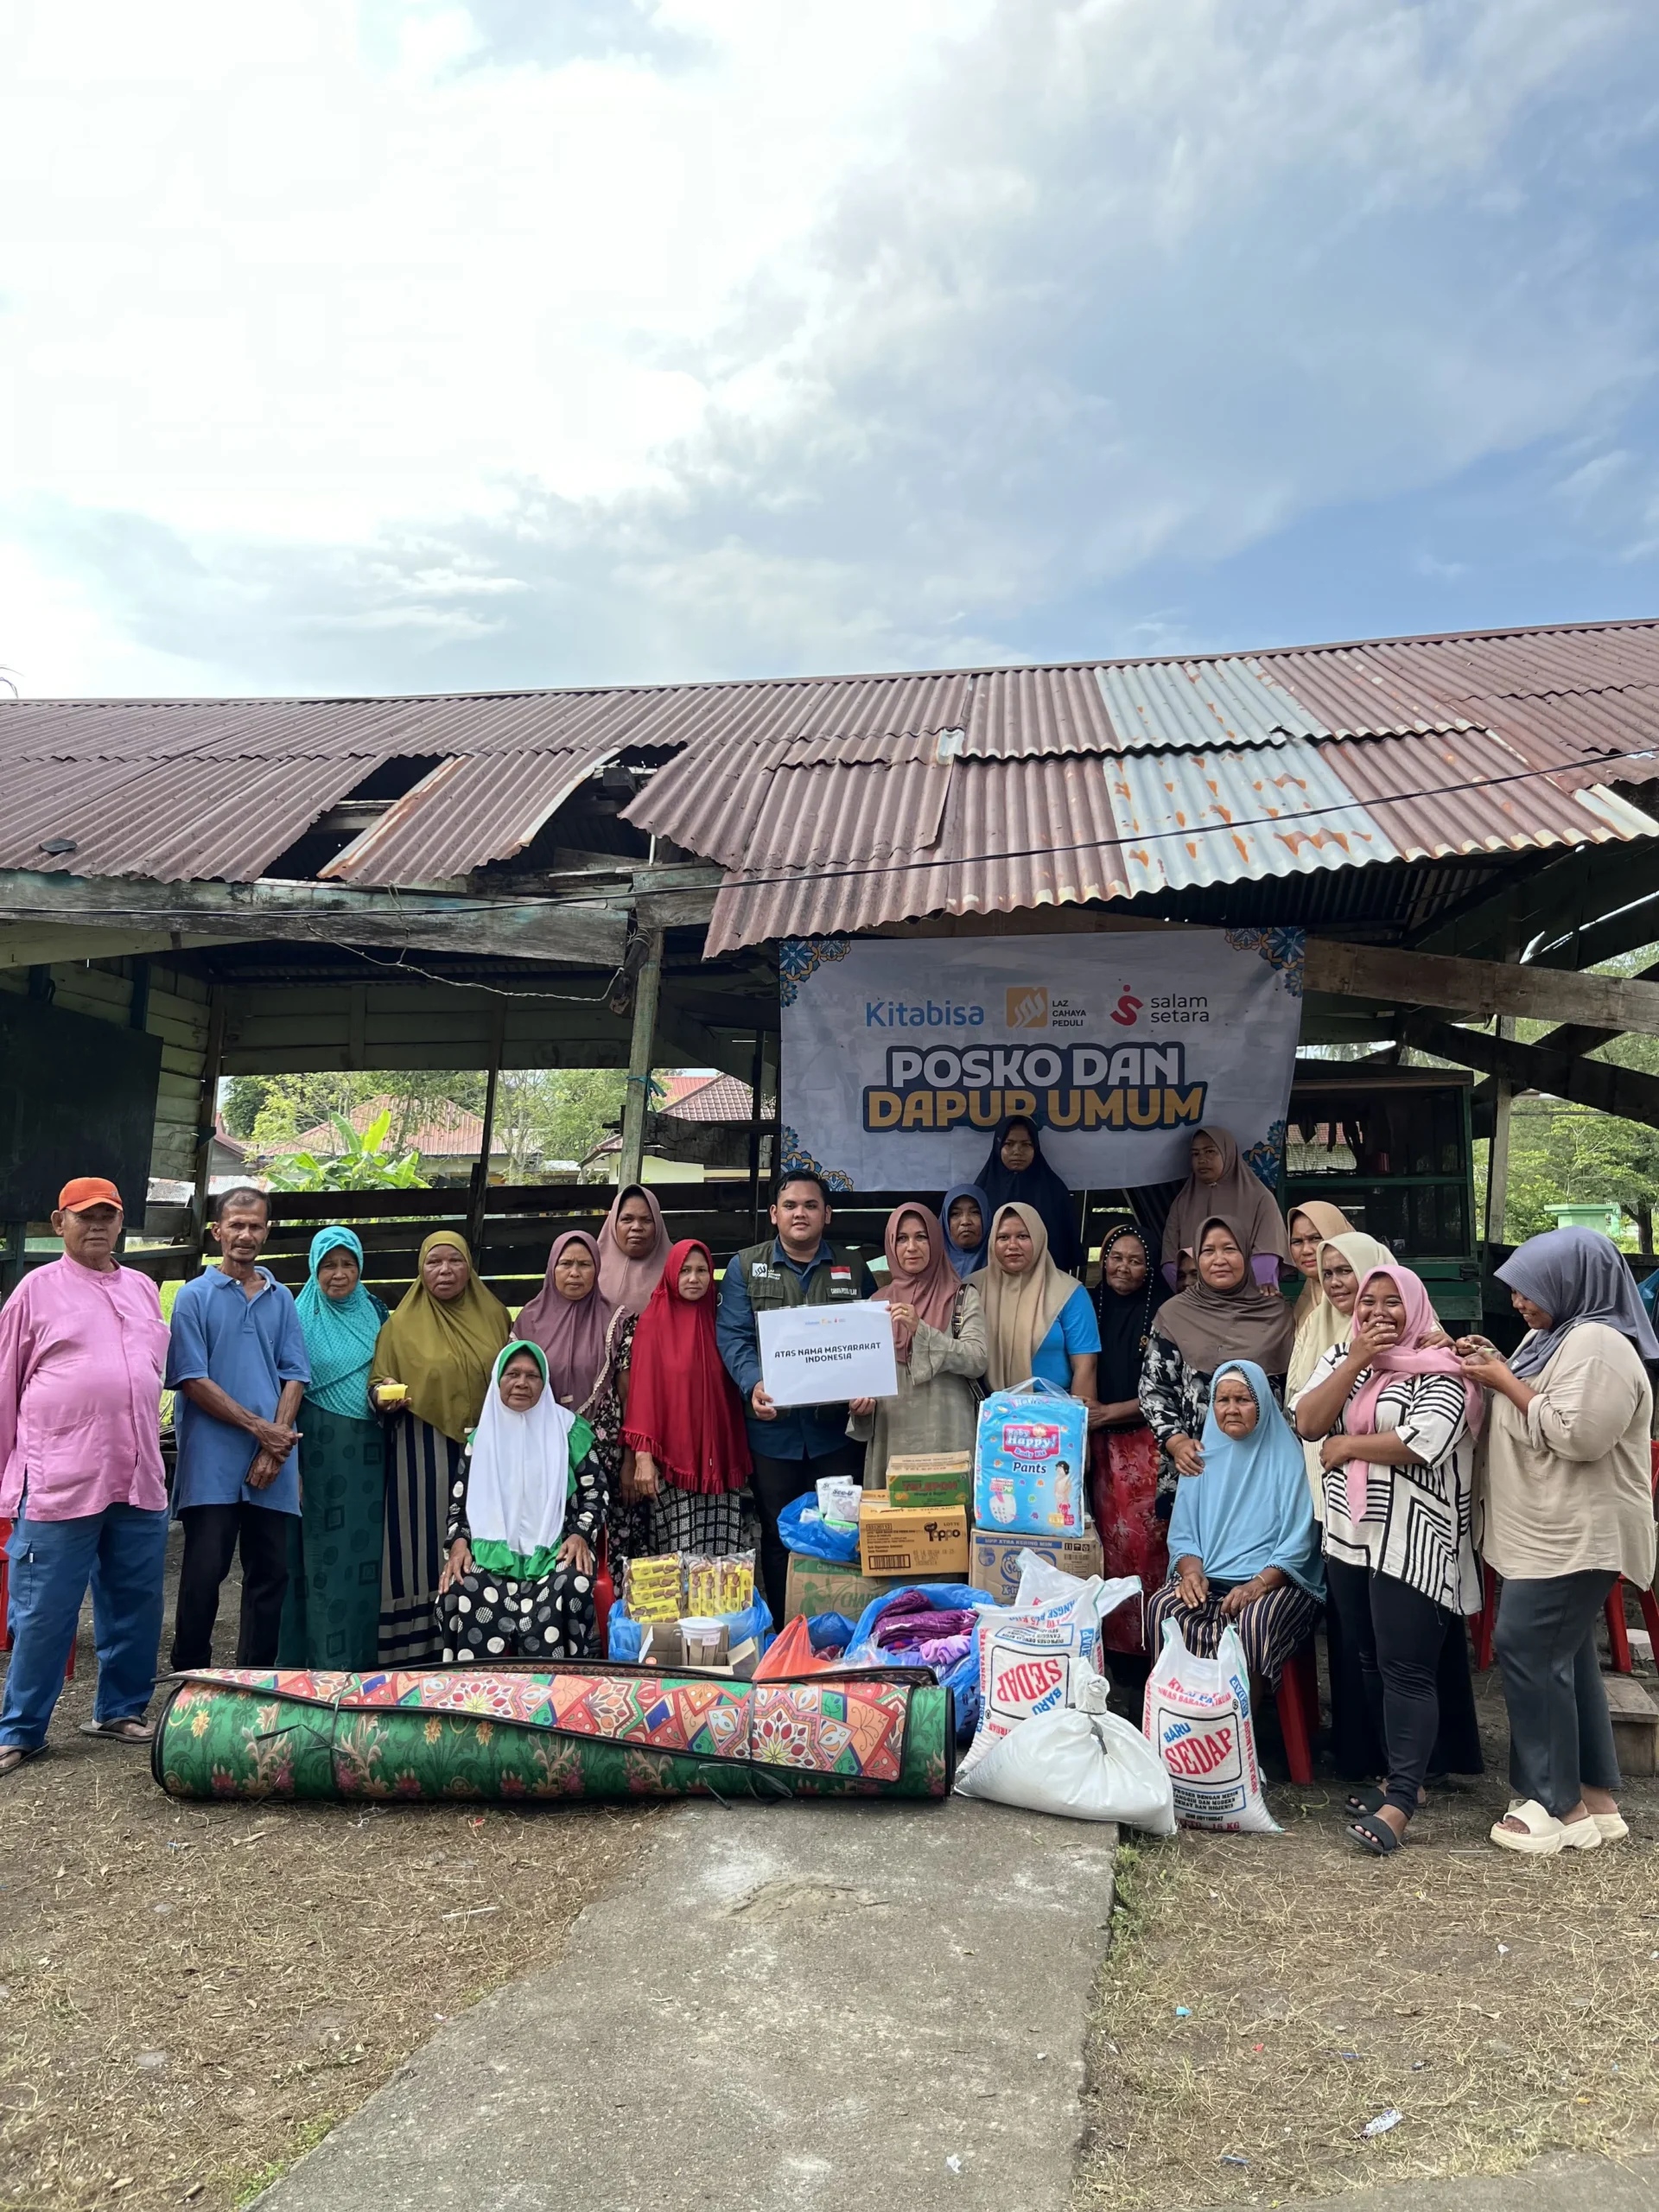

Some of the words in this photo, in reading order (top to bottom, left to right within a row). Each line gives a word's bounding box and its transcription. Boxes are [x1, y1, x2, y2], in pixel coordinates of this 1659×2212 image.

[1150, 994, 1208, 1008] salam
[866, 1000, 984, 1027] Kitabisa
[1052, 1009, 1087, 1018] CAHAYA
[1150, 1011, 1210, 1023] setara
[892, 1049, 1063, 1088] POSKO
[1072, 1047, 1179, 1086] DAN
[1047, 1087, 1204, 1127] UMUM
[774, 1350, 797, 1358] ATAS
[798, 1347, 823, 1356] NAMA
[824, 1342, 881, 1354] MASYARAKAT
[805, 1352, 852, 1363] INDONESIA
[1013, 1462, 1046, 1473] Pants
[1081, 1630, 1092, 1656] EDAP
[996, 1659, 1063, 1702] SEDAP
[1032, 1687, 1063, 1716] BARU
[1163, 1722, 1192, 1744] BARU
[1164, 1727, 1232, 1775] SEDAP
